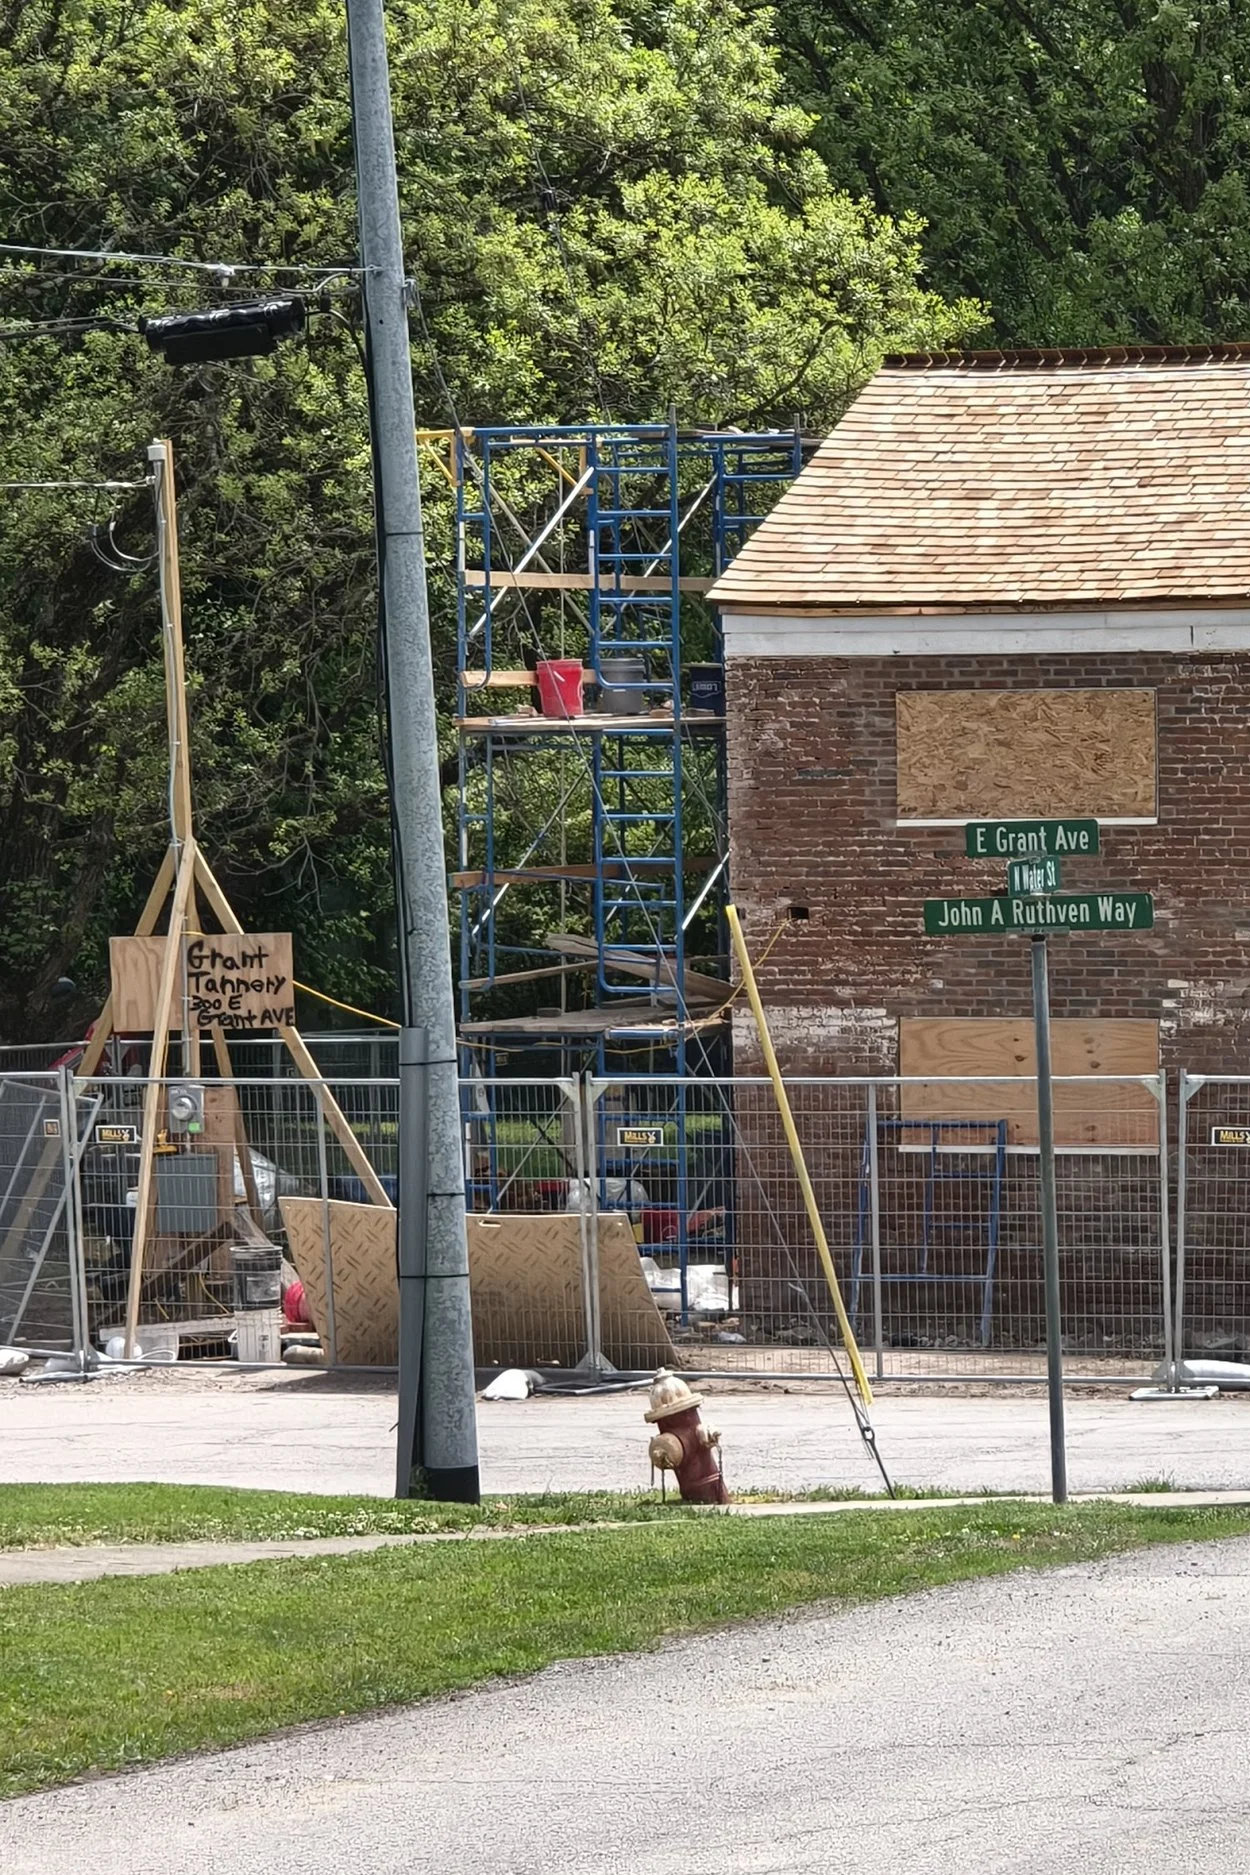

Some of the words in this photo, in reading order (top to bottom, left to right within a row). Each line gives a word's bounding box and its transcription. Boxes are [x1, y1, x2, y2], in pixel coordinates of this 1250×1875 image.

[976, 827, 988, 853] E
[996, 825, 1047, 853] Grant
[1055, 825, 1089, 851] Ave
[1014, 866, 1021, 892] N
[1022, 864, 1045, 893] Water
[1046, 860, 1057, 887] St
[938, 900, 983, 927] John
[991, 899, 1005, 926] A
[1012, 897, 1090, 925] Ruthven
[1097, 895, 1137, 928] Way
[187, 940, 270, 970] Grant
[187, 970, 287, 996] Tannery
[228, 993, 243, 1011] E
[197, 1007, 258, 1029] Grant
[260, 1006, 296, 1028] AVE
